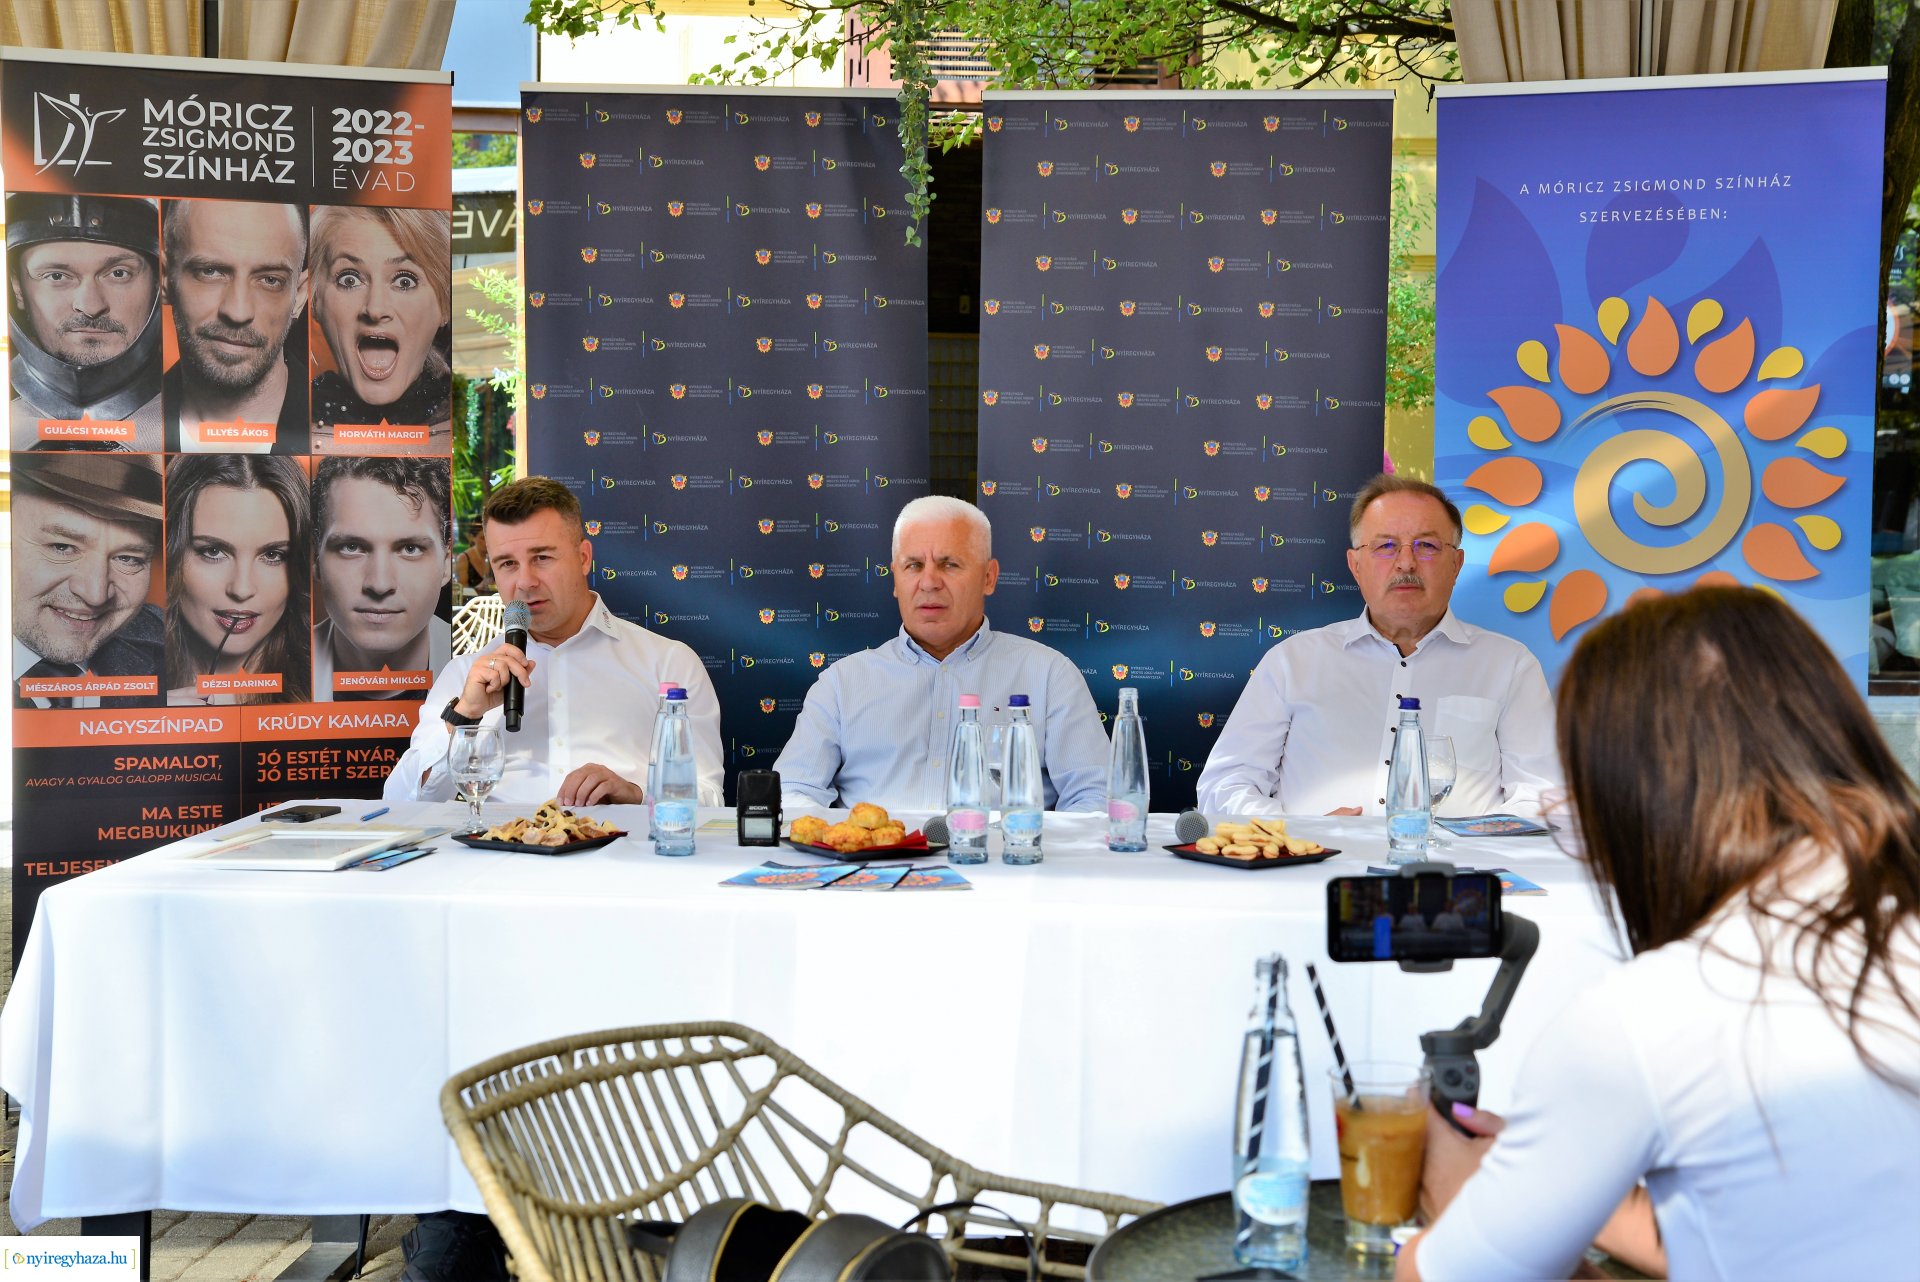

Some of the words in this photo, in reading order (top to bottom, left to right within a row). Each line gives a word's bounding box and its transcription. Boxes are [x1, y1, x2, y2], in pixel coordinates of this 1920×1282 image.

[143, 94, 293, 131] MÓRICZ
[331, 108, 424, 136] 2022-
[142, 126, 295, 153] ZSIGMOND
[331, 137, 414, 165] 2023
[143, 150, 295, 184] SZÍNHÁZ
[333, 164, 415, 192] ÉVAD
[1520, 184, 1529, 195] A
[1538, 180, 1604, 195] MÓRICZ
[1613, 179, 1706, 192] ZSIGMOND
[1715, 172, 1792, 189] SZÍNHÁZ
[1579, 207, 1728, 223] SZERVEZÉSÉBEN:
[45, 425, 89, 435] GULÁCSI
[92, 425, 128, 436] TAMÁS
[207, 427, 239, 437] ILLYÉS
[241, 427, 269, 437] ÁKOS
[339, 429, 385, 439] HORVÁTH
[388, 430, 424, 439] MARGIT
[25, 682, 82, 692] MÉSZÁROS
[85, 681, 121, 691] ÁRPÁD
[123, 682, 155, 690] ZSOLT
[202, 679, 231, 688] DÉZSI
[233, 679, 278, 688] DARINKA
[340, 676, 388, 685] JENŐVÁRI
[390, 675, 426, 684] MIKLÓS
[79, 716, 223, 735] NAGYSZÍNPAD
[258, 713, 323, 731] KRÚDY
[328, 714, 410, 729] KAMARA
[114, 754, 222, 771] SPAMALOT,
[257, 749, 281, 766] JÓ
[287, 747, 341, 765] ESTÉT
[25, 778, 65, 787] AVAGY
[66, 777, 75, 786] A
[77, 776, 123, 786] GYALOG
[126, 774, 172, 784] GALOPP
[174, 773, 223, 782] MUSICAL
[257, 765, 281, 782] JÓ
[287, 764, 341, 781] ESTÉT
[346, 765, 395, 779] SZER
[142, 806, 172, 820] MA
[178, 805, 223, 819] ESTE
